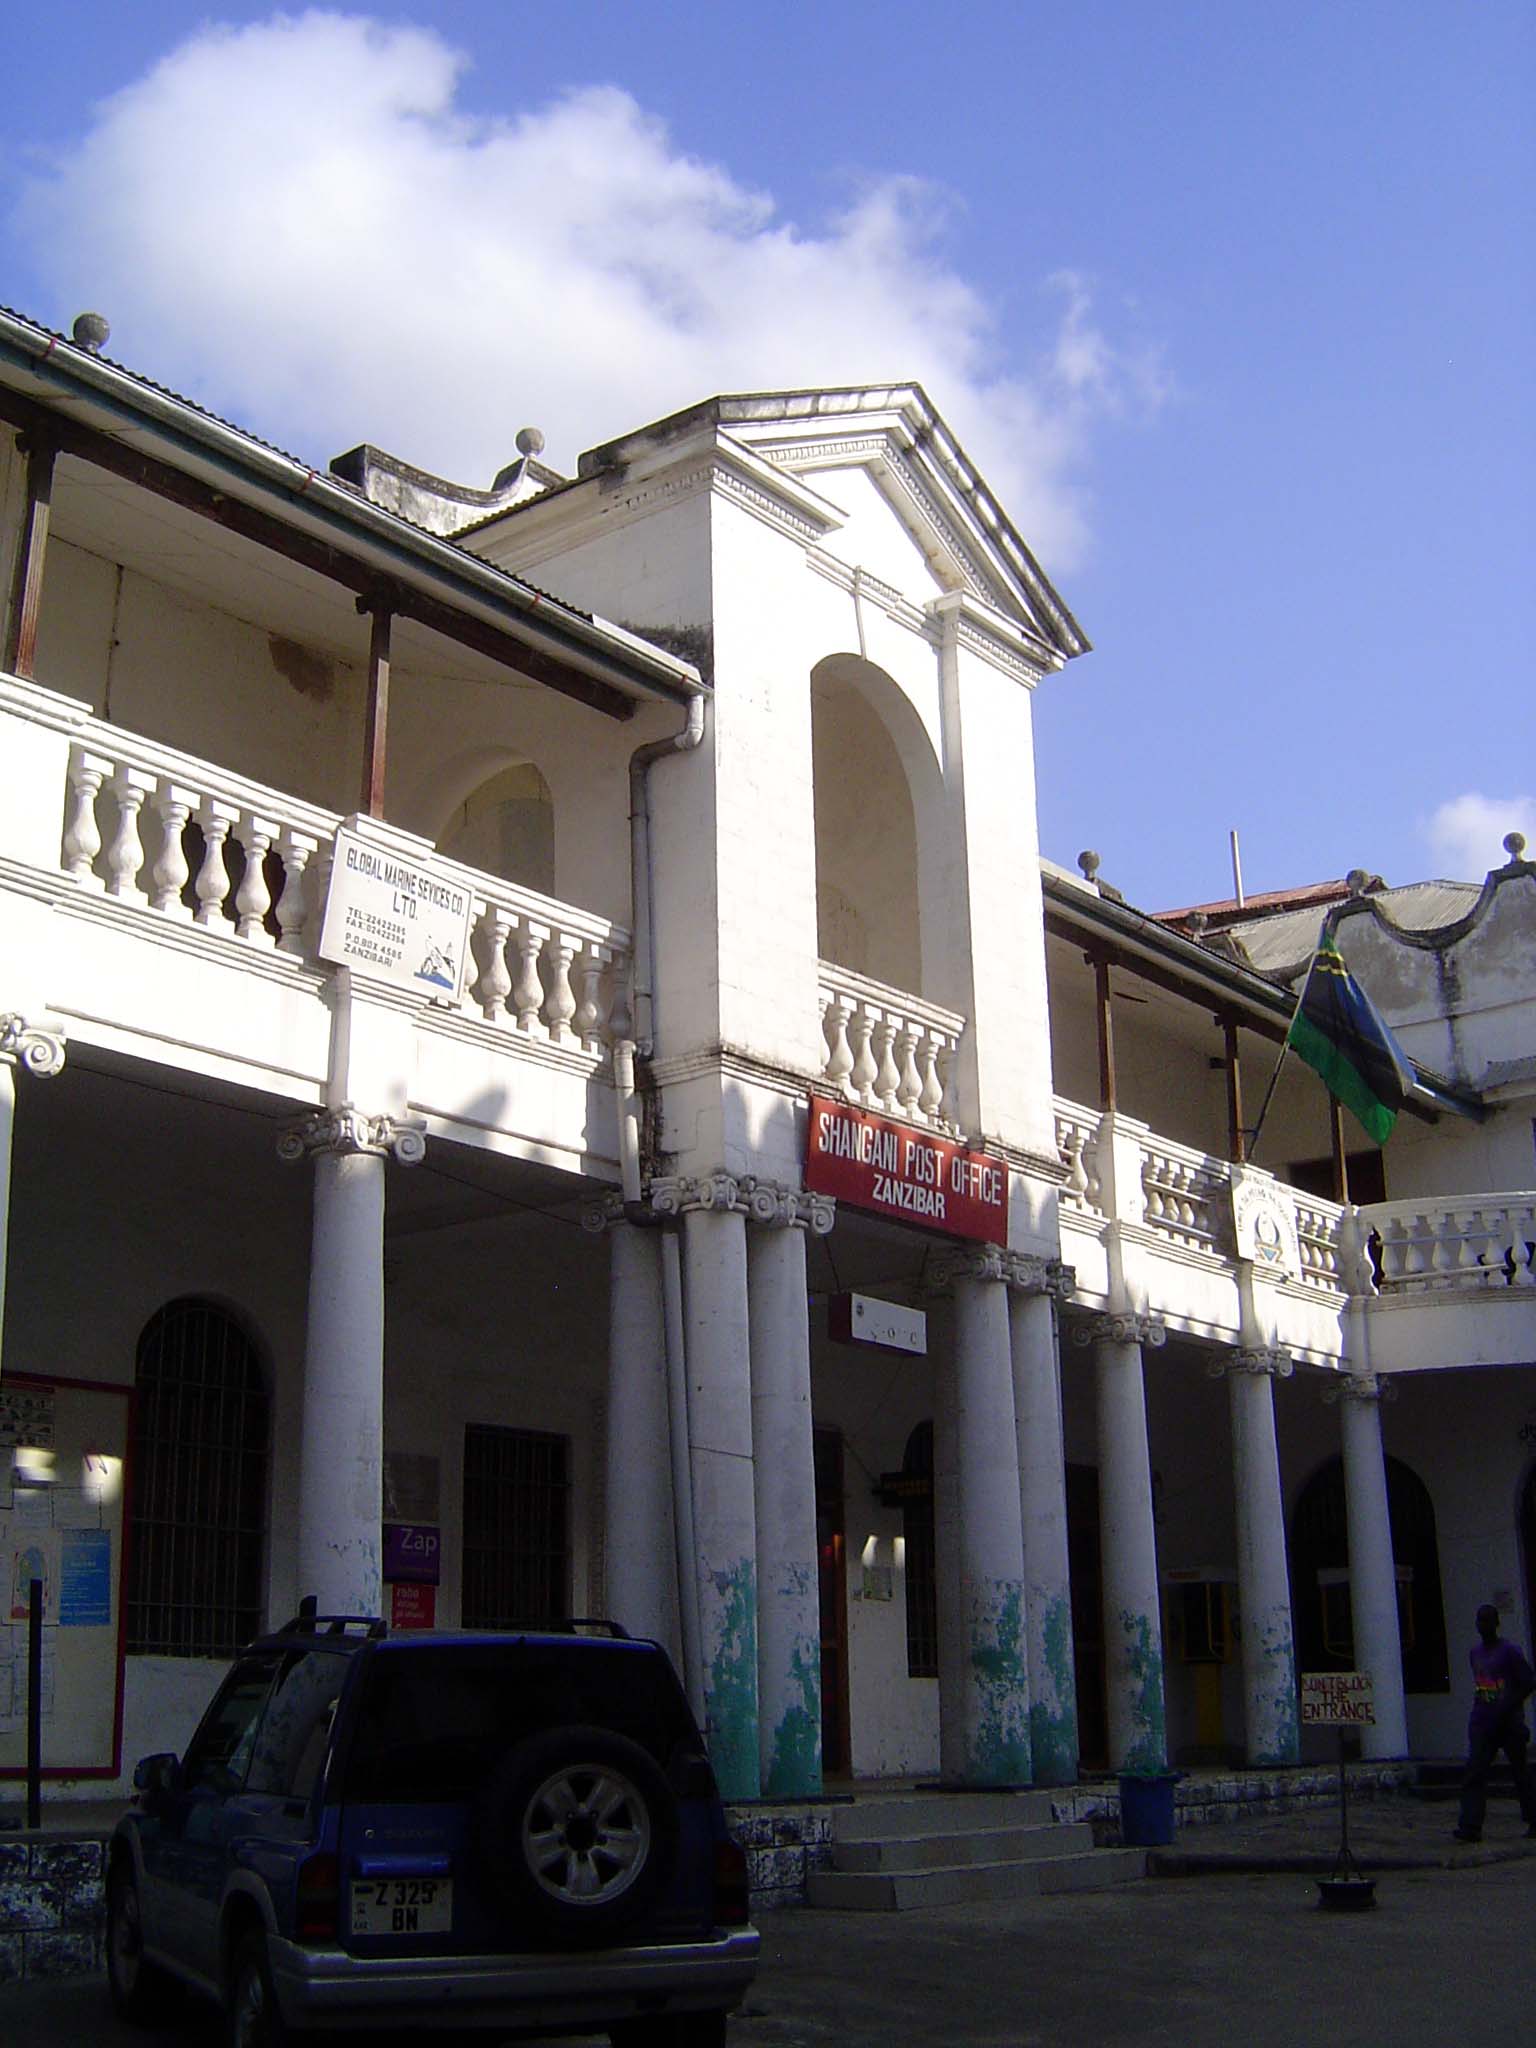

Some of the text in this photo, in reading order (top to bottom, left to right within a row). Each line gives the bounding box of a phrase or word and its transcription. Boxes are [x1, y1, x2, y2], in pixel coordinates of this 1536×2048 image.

[346, 848, 382, 880] GLOBAL
[384, 863, 417, 894] MARINE
[819, 1112, 1002, 1205] SHANGANI POST OFFICE
[873, 1173, 945, 1219] ZANZIBAR
[400, 1528, 438, 1557] Zap
[1303, 1702, 1375, 1720] ENTRANCE
[1321, 1690, 1349, 1704] THE
[395, 1882, 433, 1905] 325
